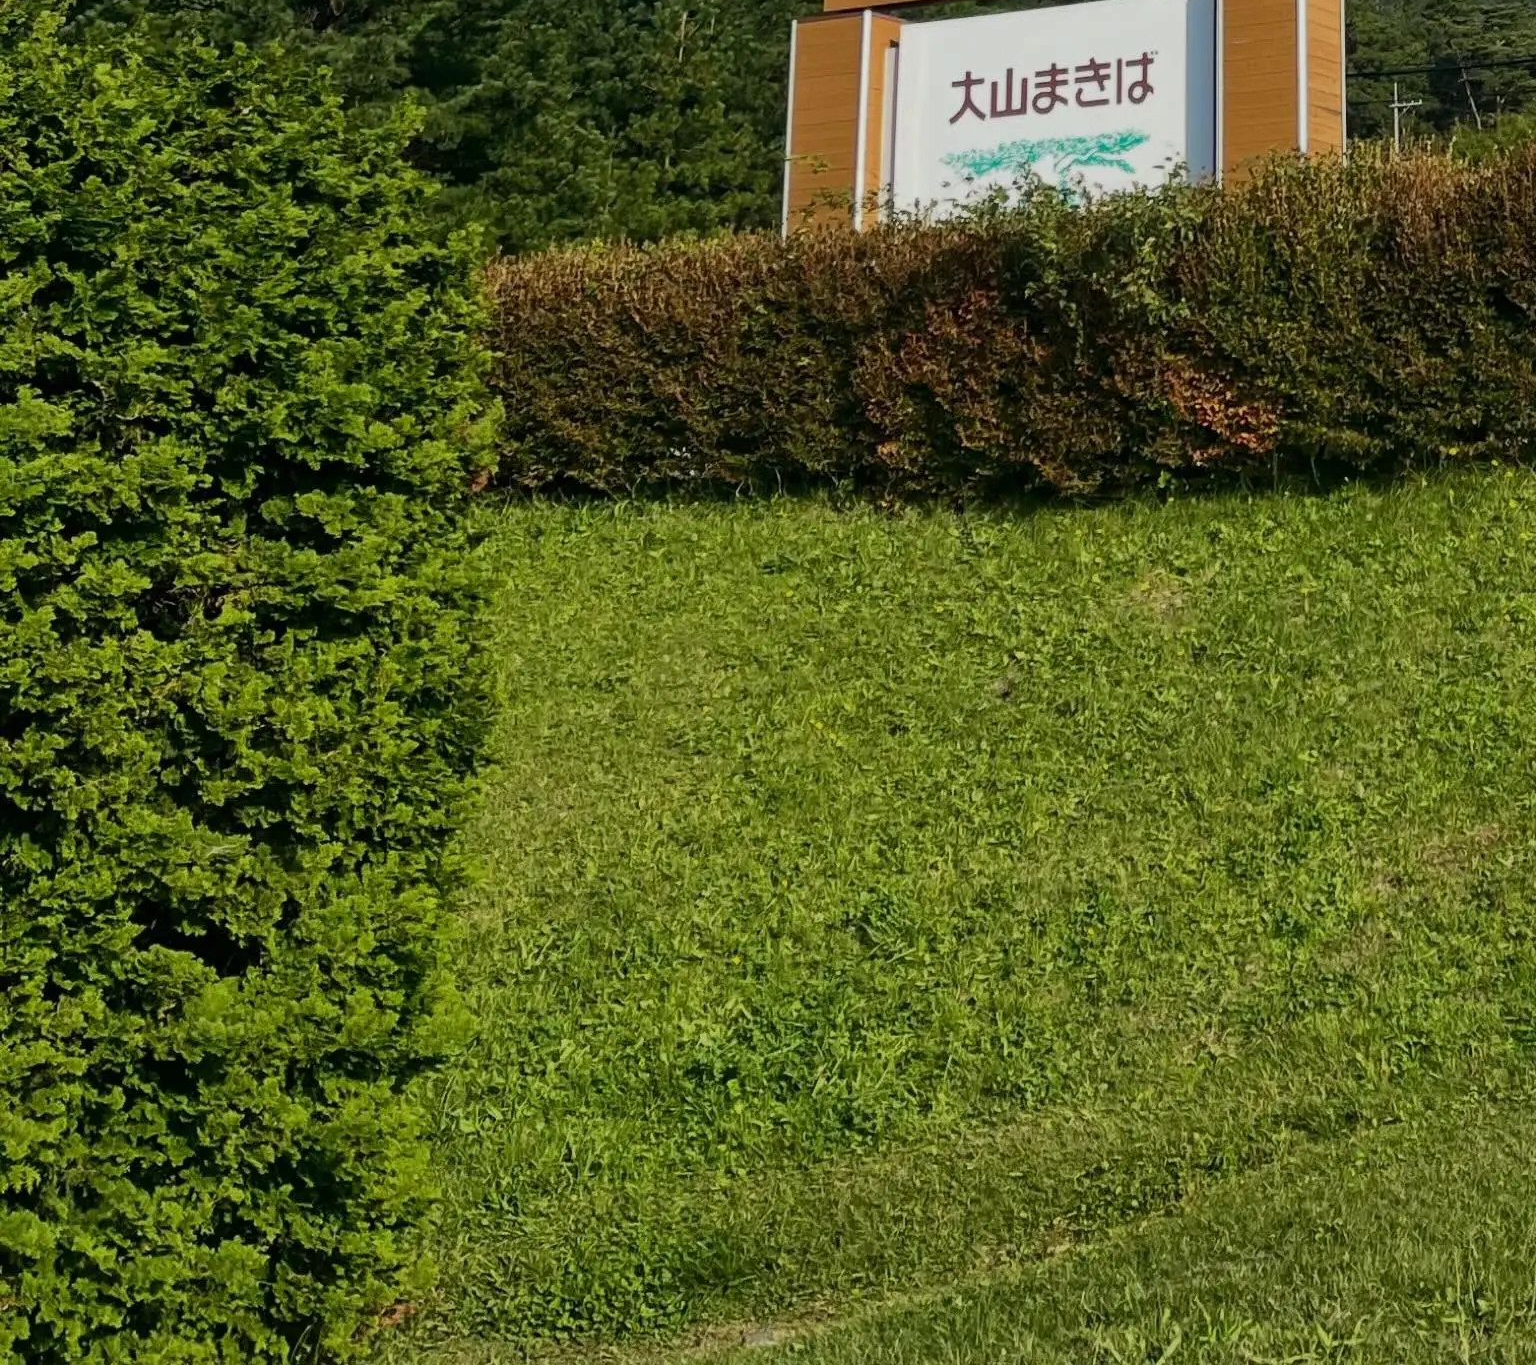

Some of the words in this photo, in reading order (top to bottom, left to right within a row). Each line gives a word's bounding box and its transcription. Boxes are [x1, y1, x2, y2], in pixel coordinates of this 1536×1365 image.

[948, 50, 1158, 125] 大山まきば
